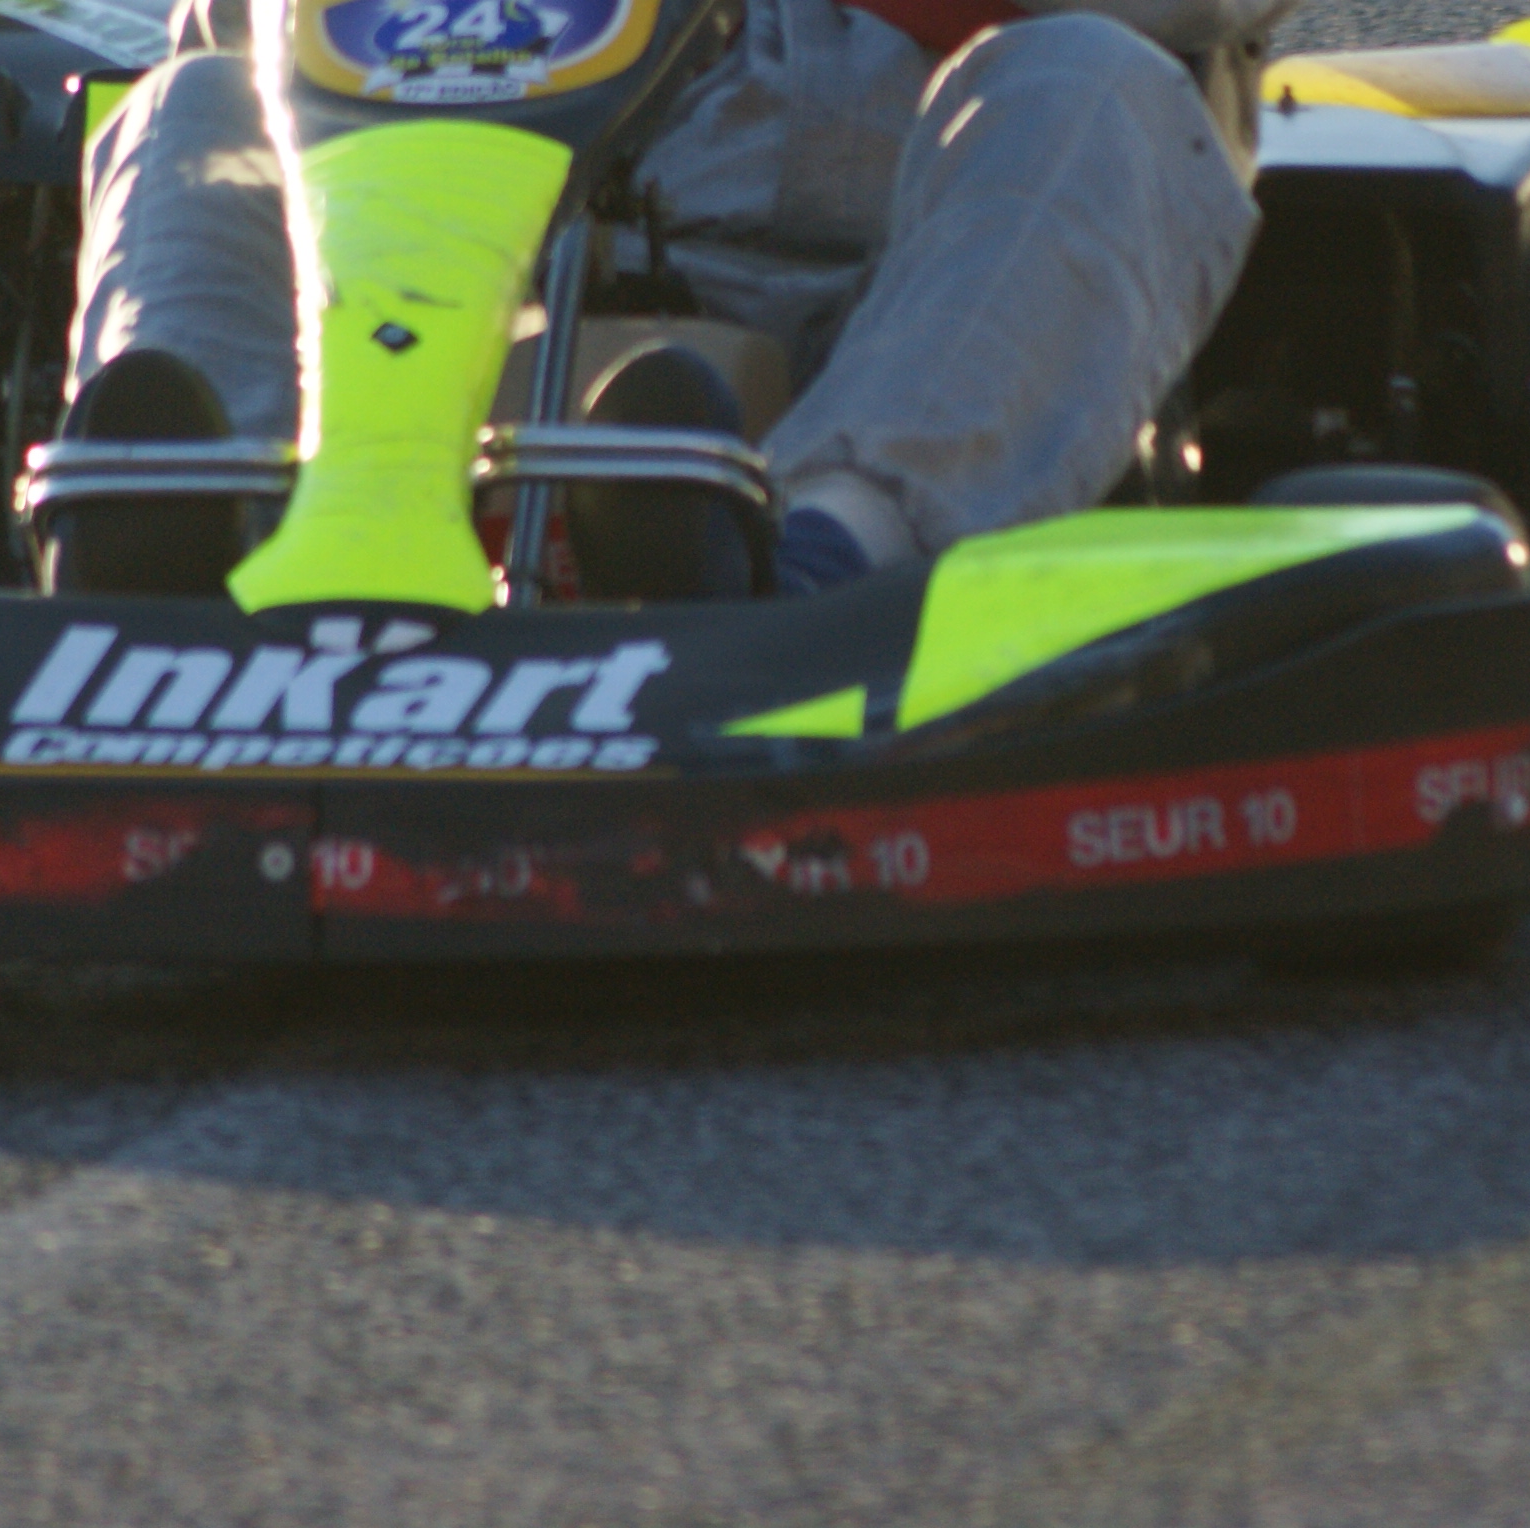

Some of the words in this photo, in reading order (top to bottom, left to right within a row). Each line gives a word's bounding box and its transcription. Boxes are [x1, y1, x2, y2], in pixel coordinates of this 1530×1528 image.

[396, 0, 506, 50] 24
[1067, 796, 1227, 867] SEUR
[1241, 788, 1297, 848] 10
